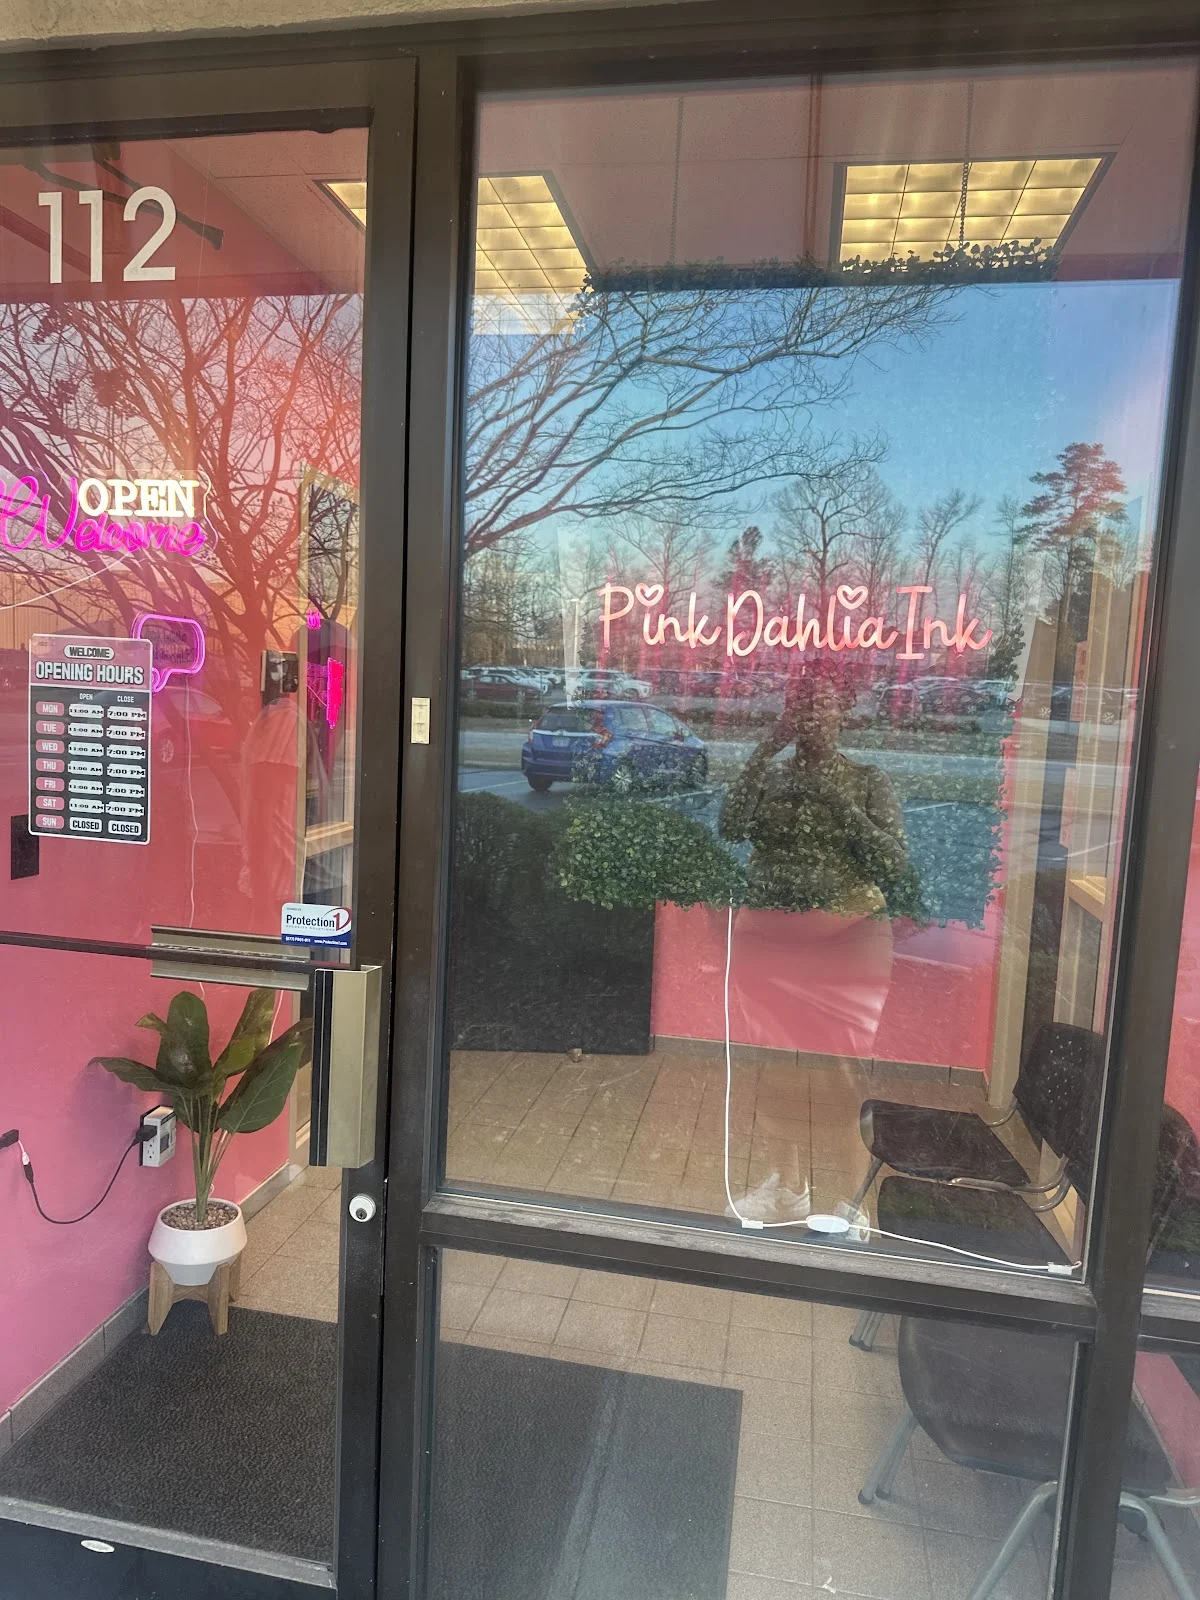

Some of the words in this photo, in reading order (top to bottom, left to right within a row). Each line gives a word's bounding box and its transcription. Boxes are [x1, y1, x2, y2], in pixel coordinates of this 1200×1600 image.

[38, 186, 177, 284] 112
[78, 477, 200, 518] OPEN
[597, 582, 722, 649] Pink
[726, 584, 899, 657] Dahlia
[896, 585, 994, 660] Ink
[69, 646, 110, 658] WELCOME
[35, 660, 93, 681] OPENING
[96, 664, 144, 685] HOURS
[117, 695, 135, 703] CLOSE
[42, 704, 59, 714] MON
[42, 723, 57, 732] TUE
[41, 742, 58, 751] WED
[42, 761, 57, 770] THU
[44, 780, 56, 789] FRI
[43, 798, 57, 808] SAT
[42, 817, 57, 826] SUN
[72, 820, 100, 830] CLOSED
[111, 823, 139, 833] CLOSED
